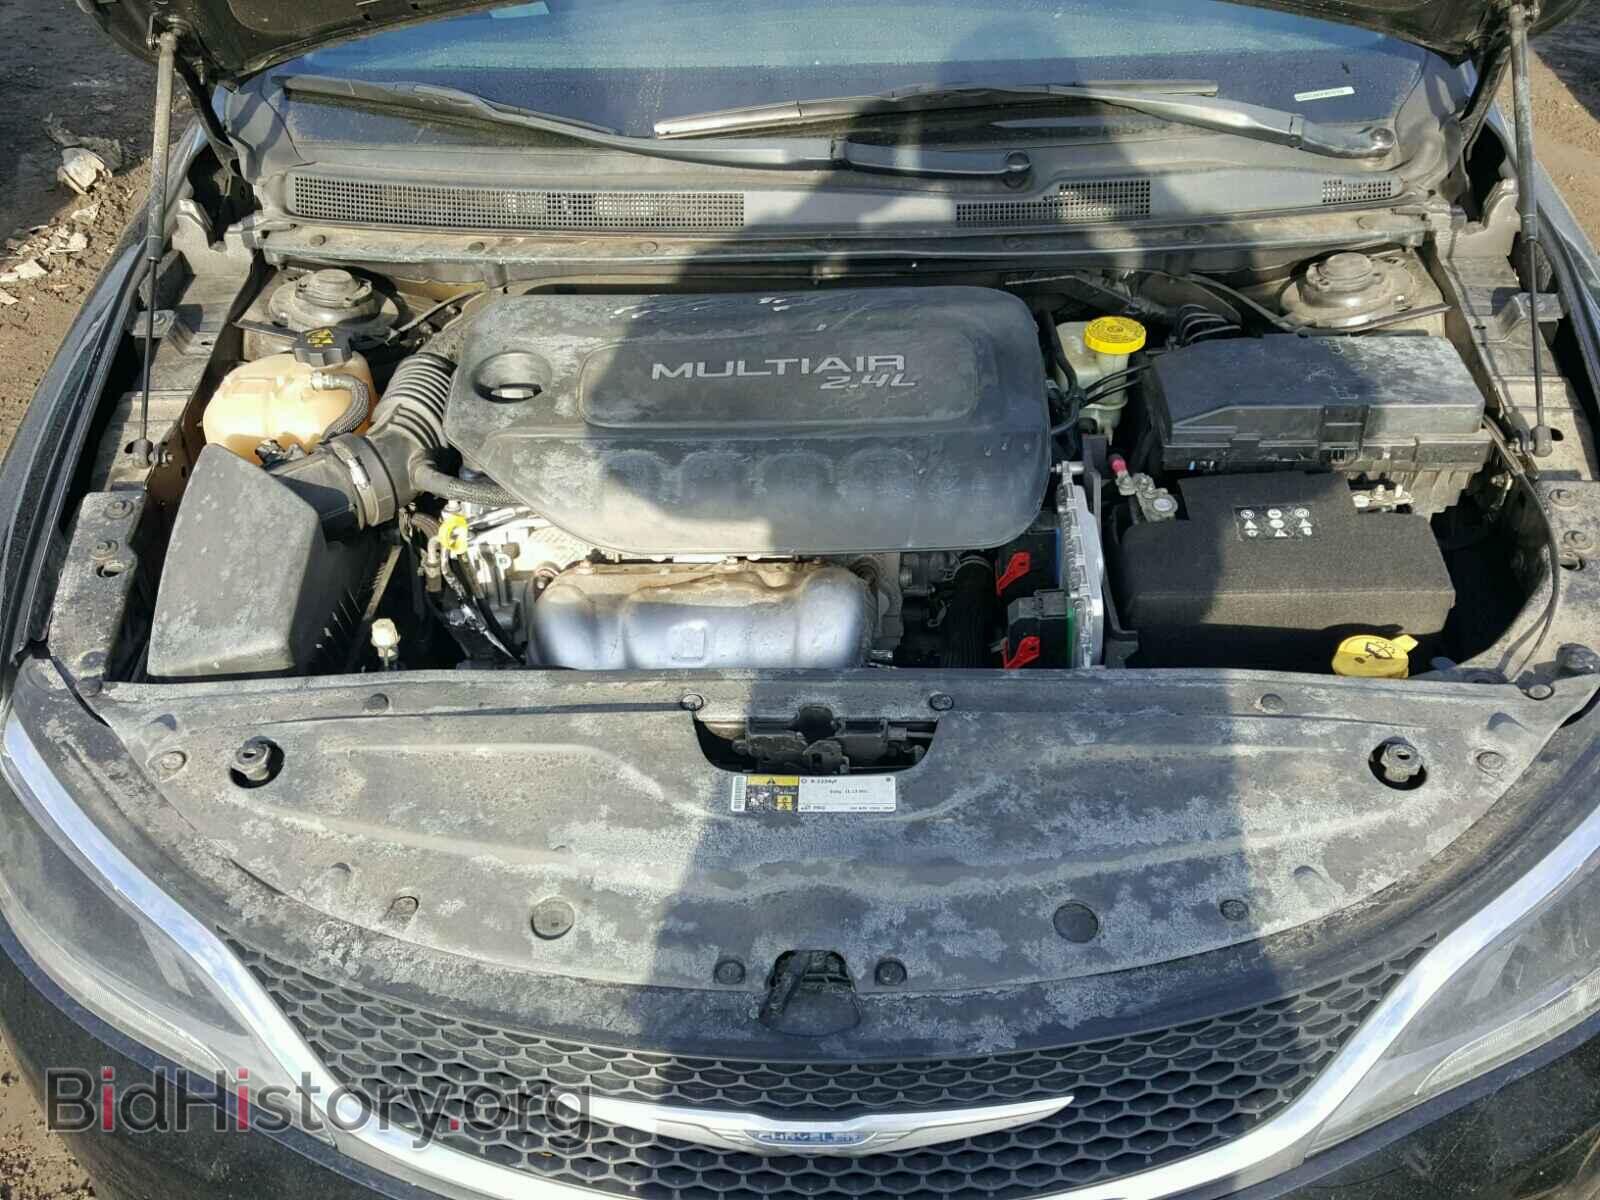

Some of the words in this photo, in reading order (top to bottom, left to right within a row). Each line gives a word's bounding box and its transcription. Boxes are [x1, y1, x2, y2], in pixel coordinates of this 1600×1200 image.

[651, 354, 905, 380] MULTIAIR
[819, 373, 915, 390] 2.4L
[757, 1131, 864, 1143] CHRYL
